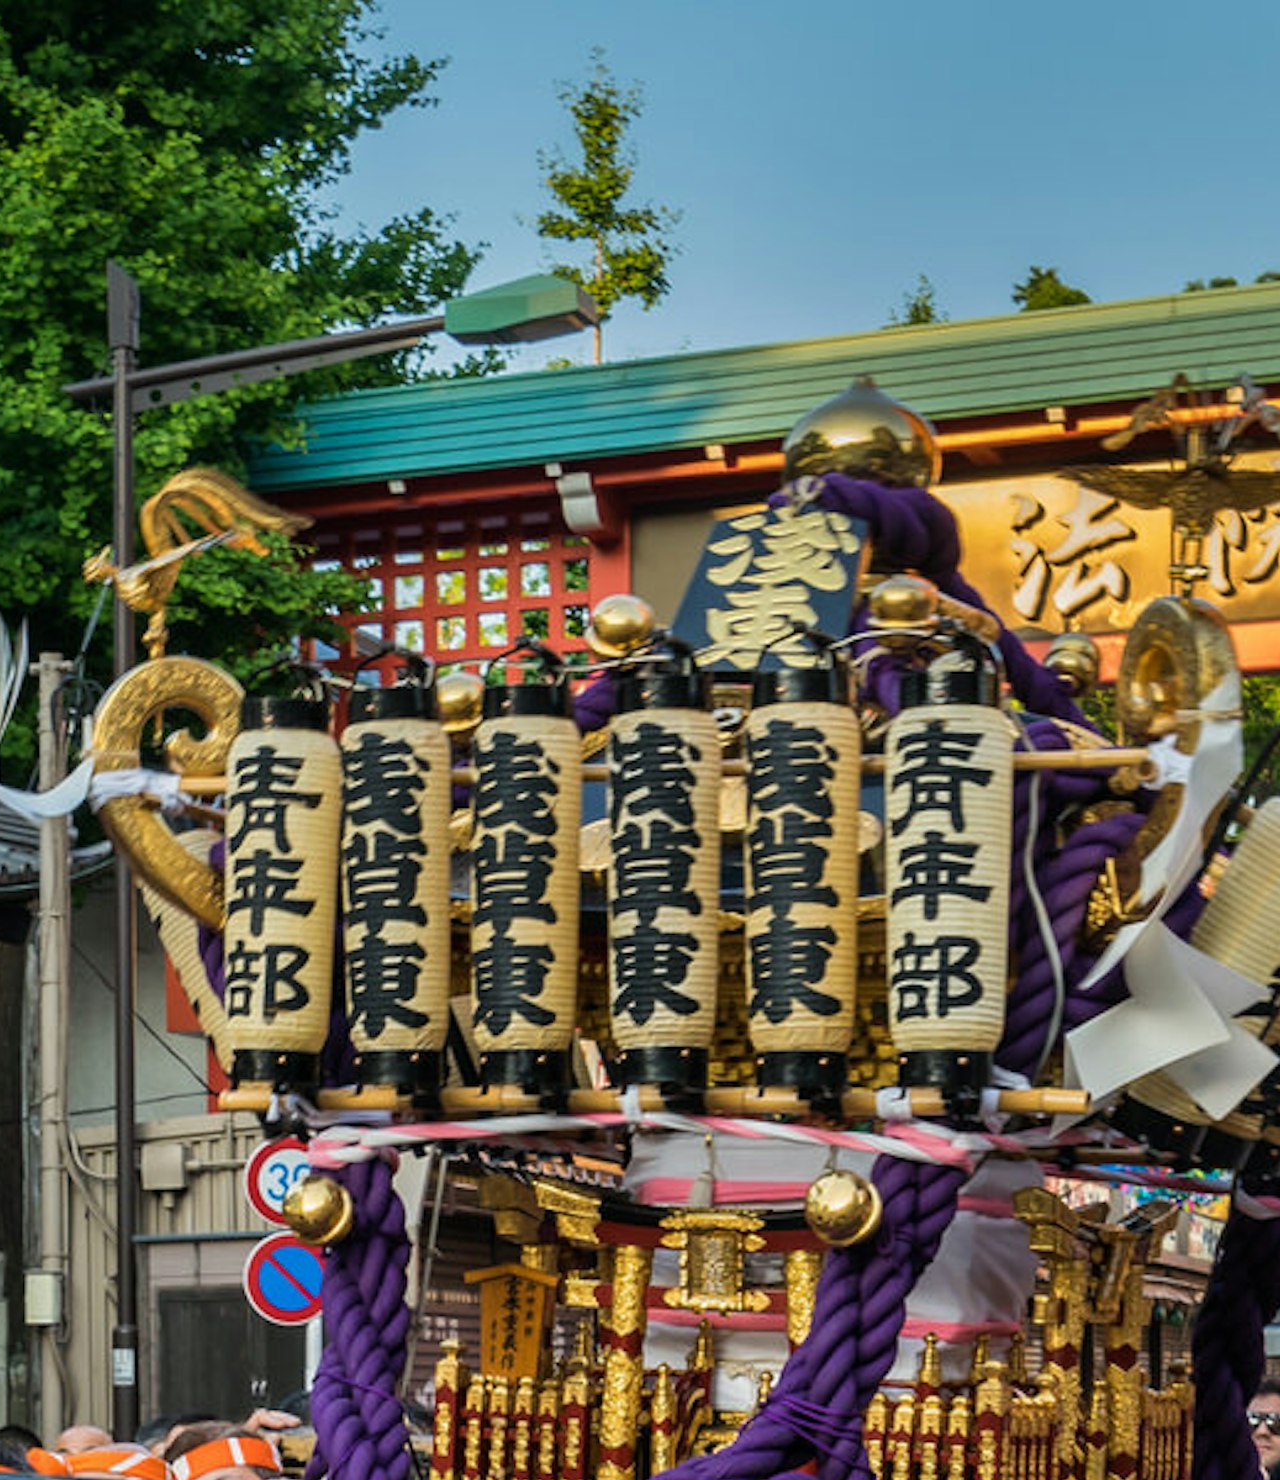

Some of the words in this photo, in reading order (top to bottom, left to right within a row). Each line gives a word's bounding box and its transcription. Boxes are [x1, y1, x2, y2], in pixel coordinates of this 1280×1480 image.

[228, 746, 323, 1026] 青年部
[892, 720, 995, 1022] 青年部
